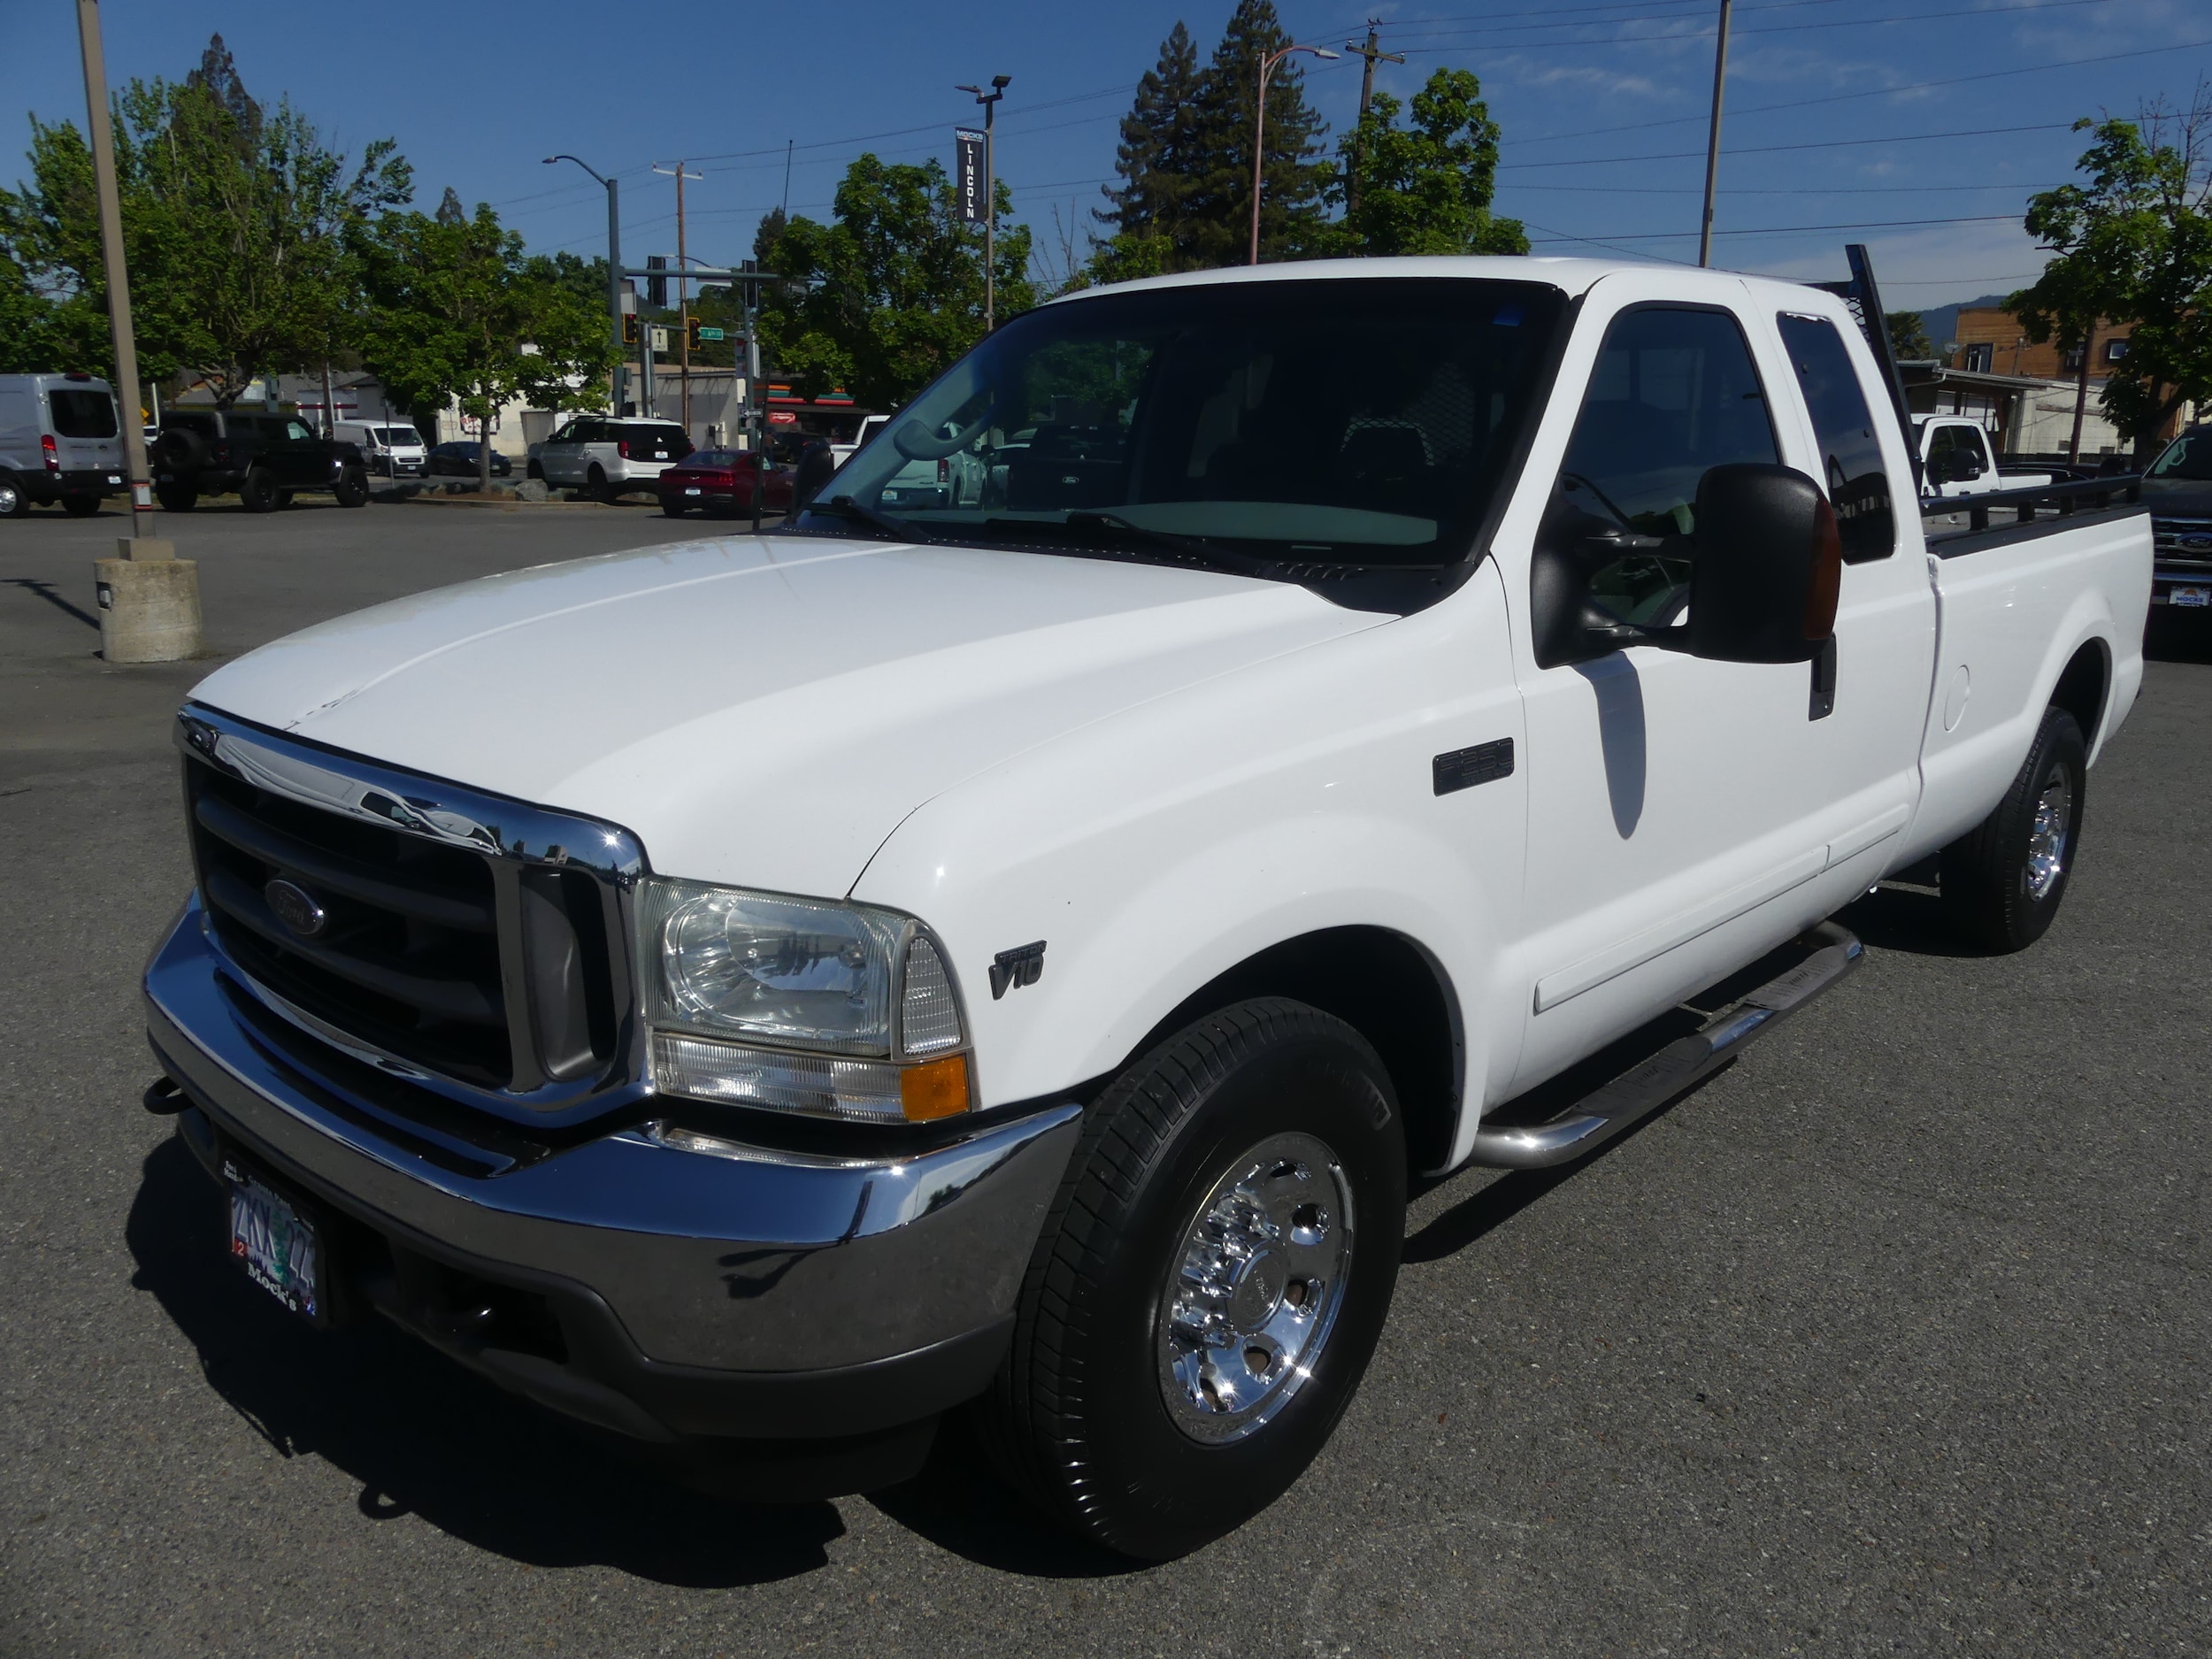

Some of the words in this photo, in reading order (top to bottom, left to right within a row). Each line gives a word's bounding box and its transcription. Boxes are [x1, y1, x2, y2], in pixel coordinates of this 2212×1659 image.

[278, 890, 305, 926] Ford
[988, 956, 1044, 1001] V10
[248, 1263, 297, 1312] Mock's
